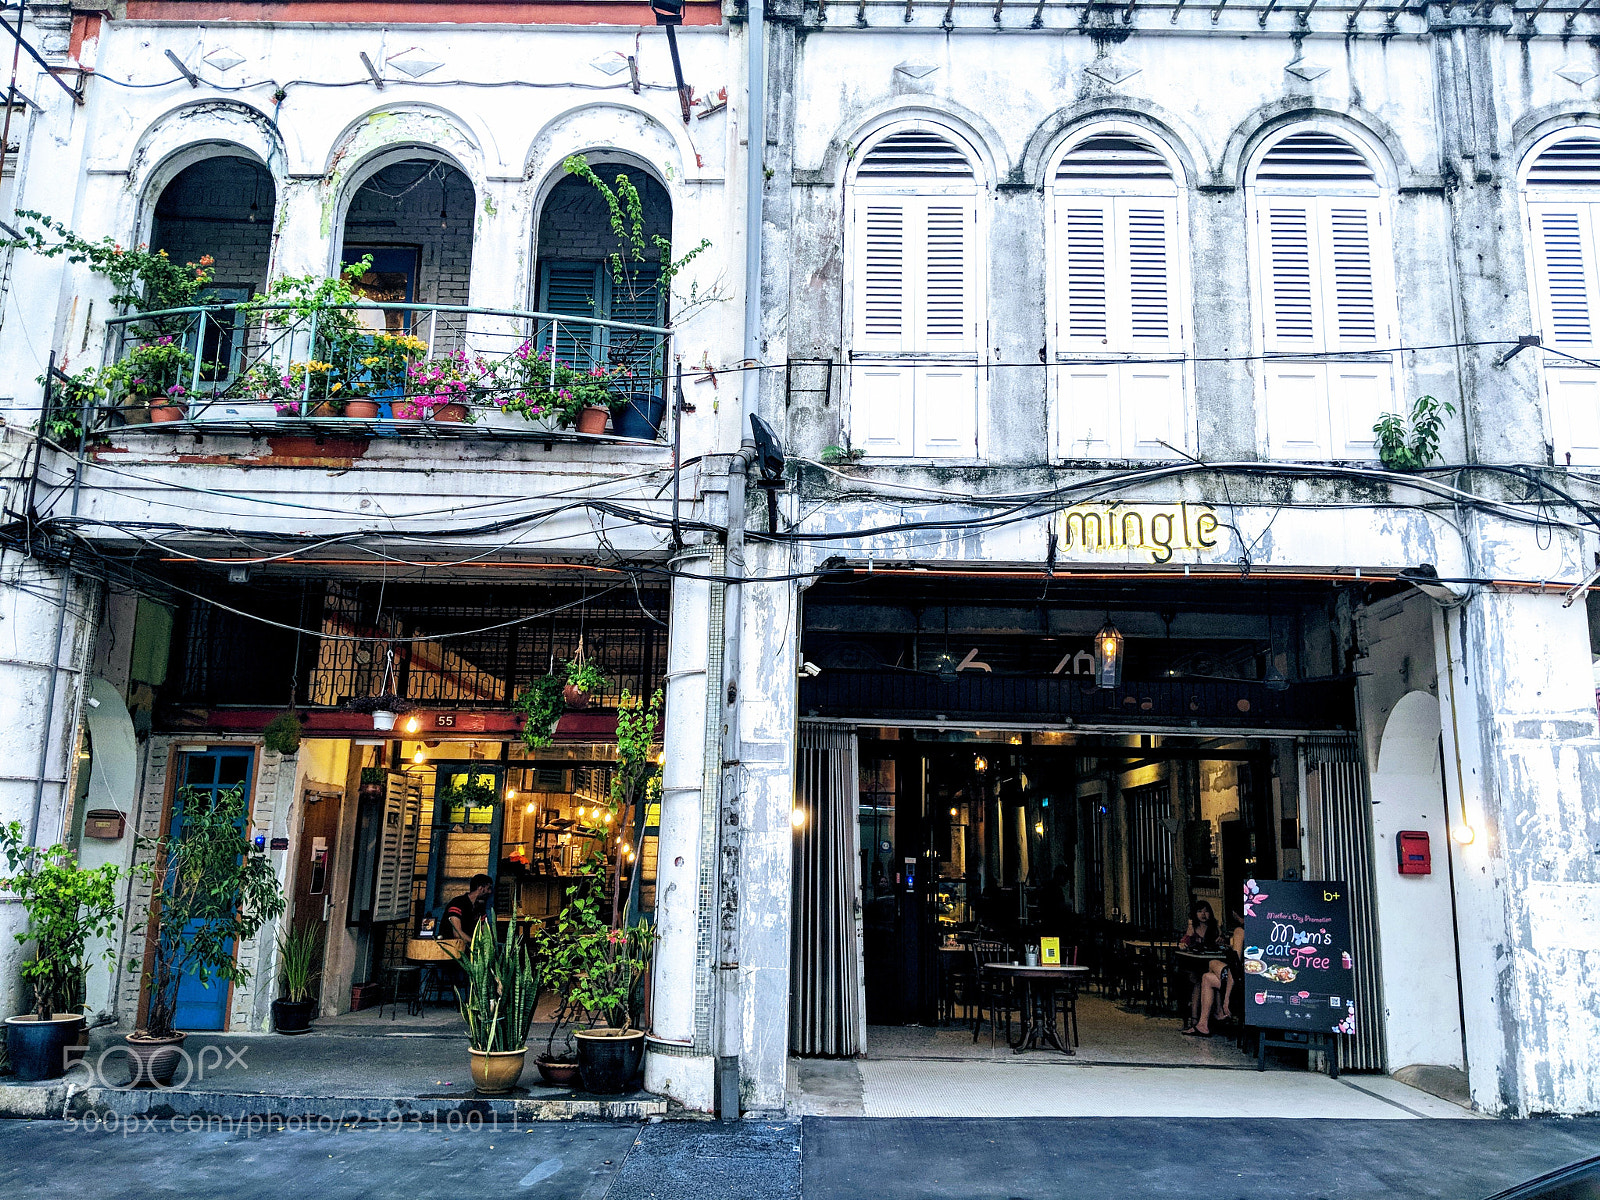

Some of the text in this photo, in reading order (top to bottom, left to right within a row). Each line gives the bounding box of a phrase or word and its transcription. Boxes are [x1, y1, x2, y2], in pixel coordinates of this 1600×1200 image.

[438, 716, 453, 726] 55
[1323, 889, 1341, 902] b+
[1266, 912, 1332, 924] Mother's Day Promotion
[1266, 942, 1291, 956] eat
[1289, 946, 1330, 969] Free
